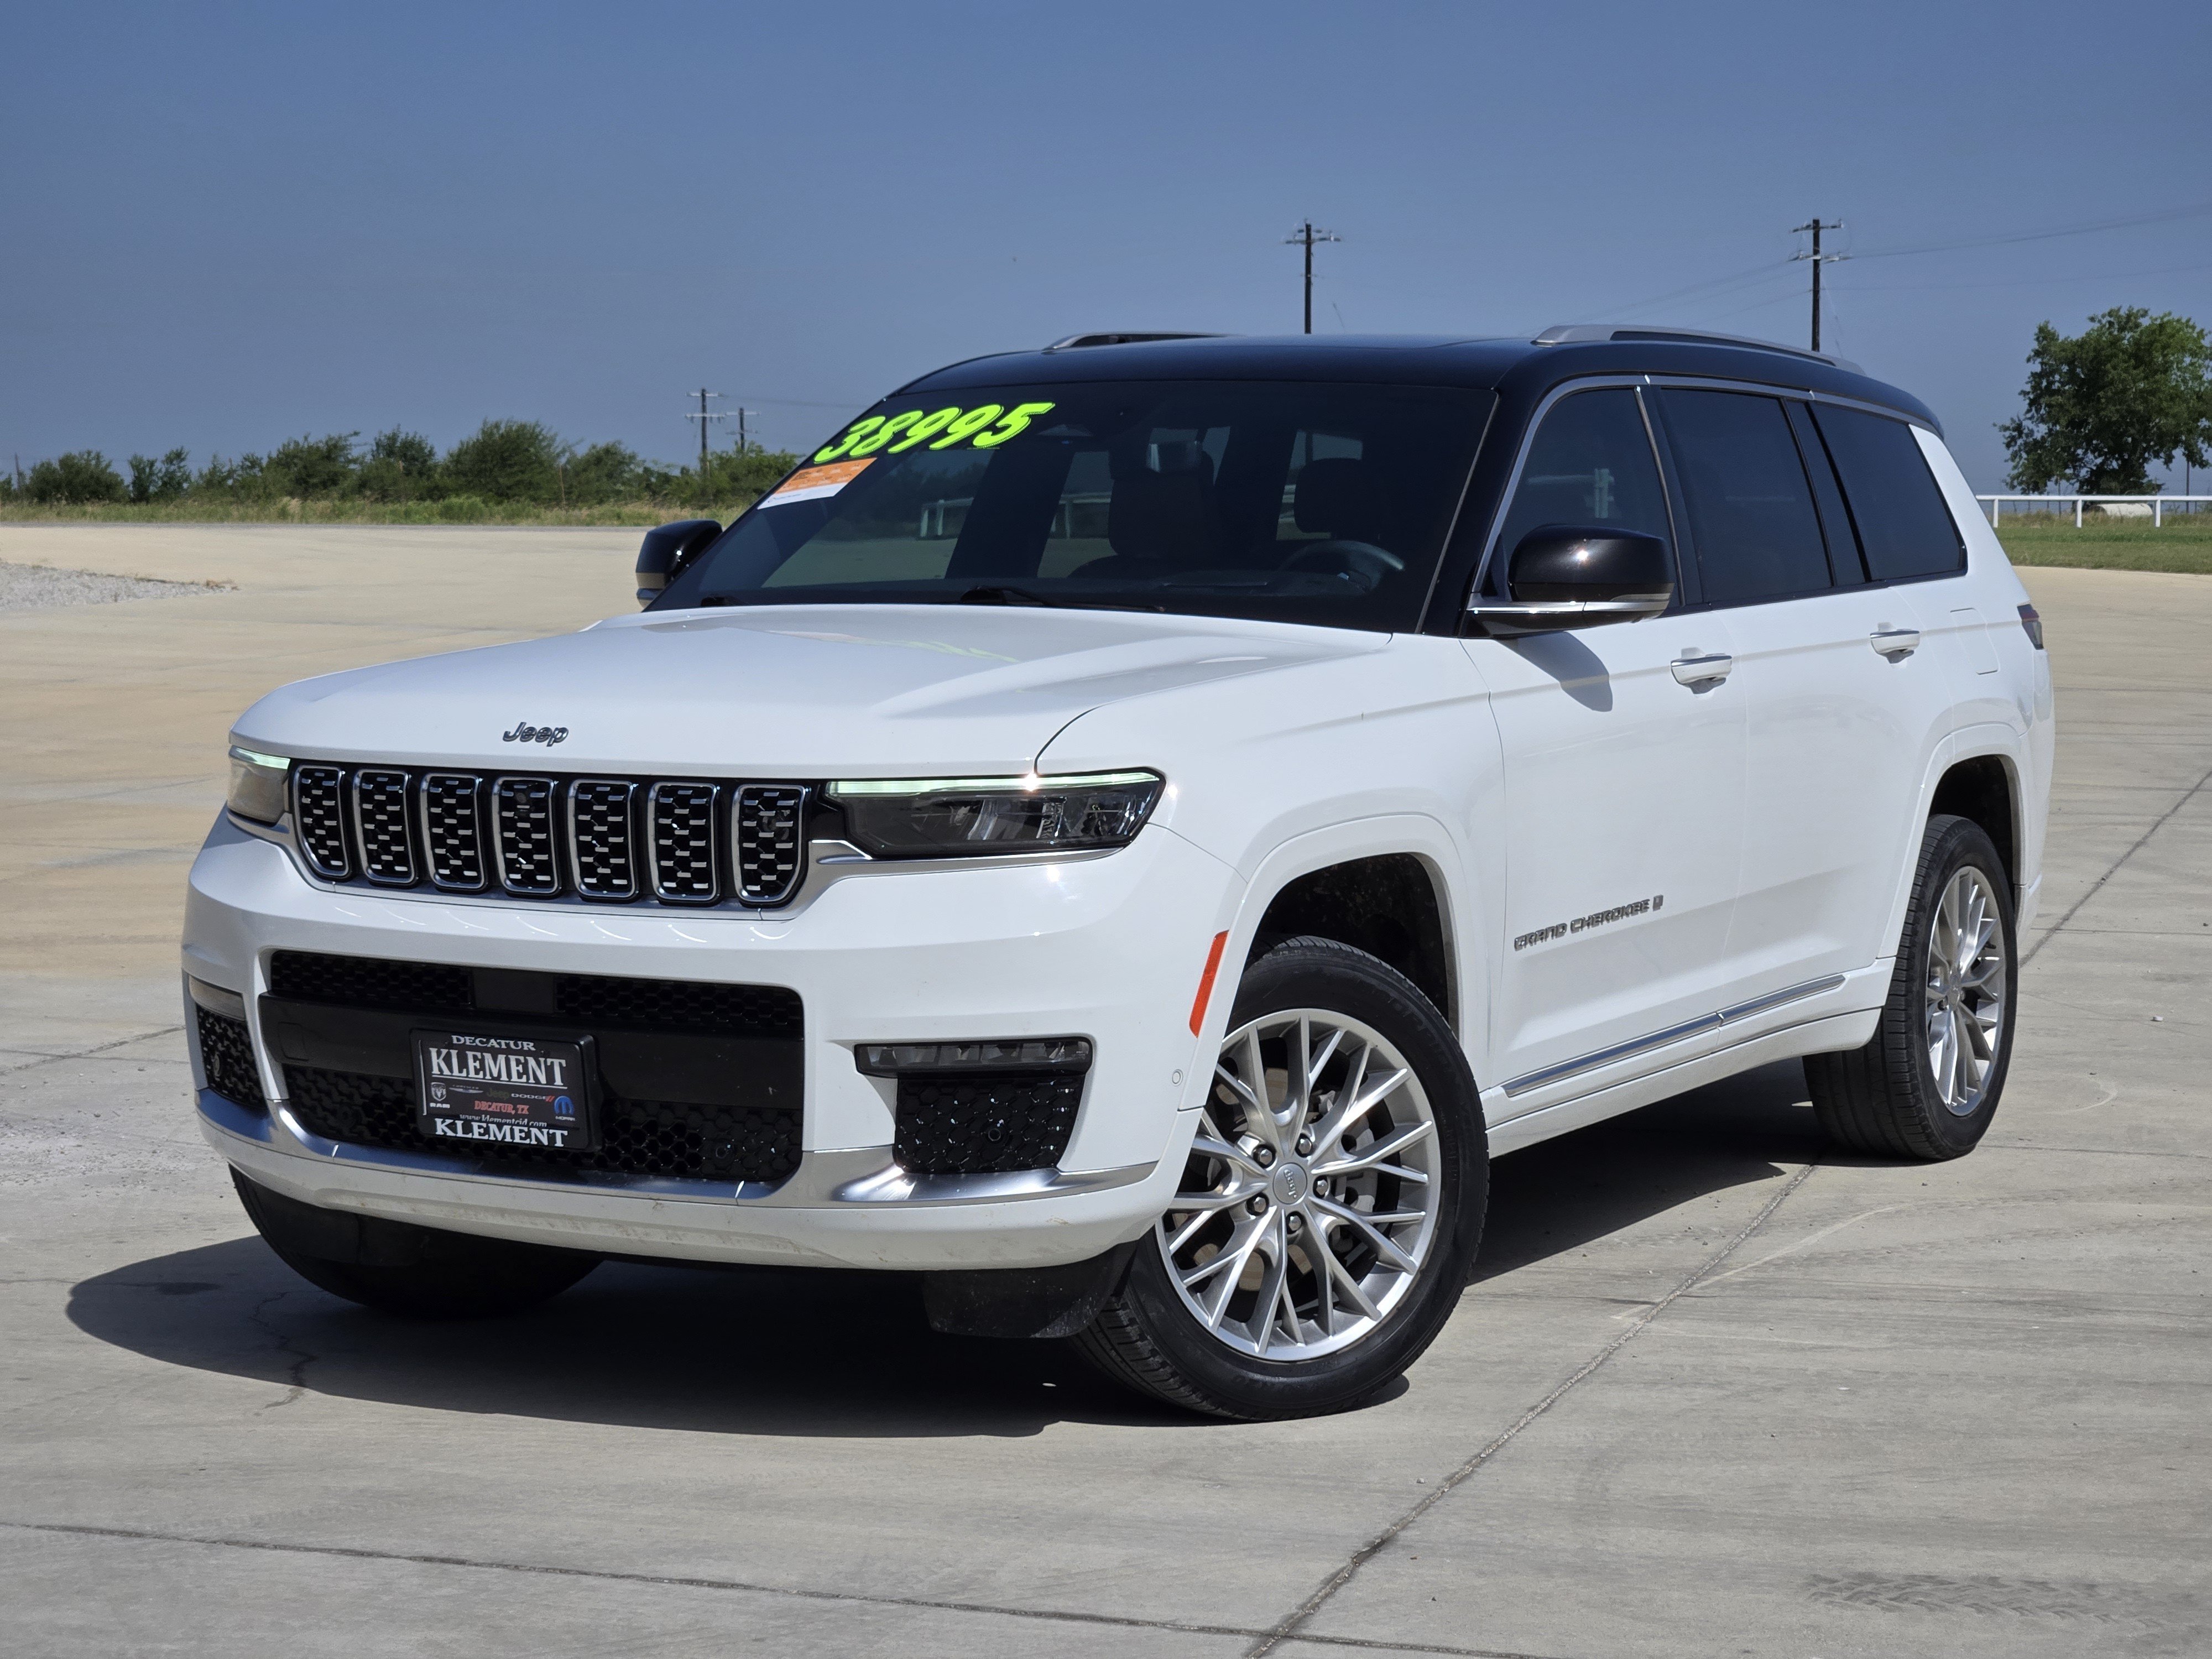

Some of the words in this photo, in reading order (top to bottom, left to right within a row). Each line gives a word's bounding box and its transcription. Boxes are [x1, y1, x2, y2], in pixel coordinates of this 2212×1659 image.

[813, 402, 1055, 465] 38995
[502, 722, 569, 747] Jeep
[1514, 923, 1568, 952] GRAND
[1570, 899, 1650, 934] CHEROKEE
[451, 1035, 536, 1051] DECATUR
[429, 1047, 566, 1086] KLEMENT
[517, 1104, 530, 1114] TX
[435, 1118, 568, 1147] KLEMENT
